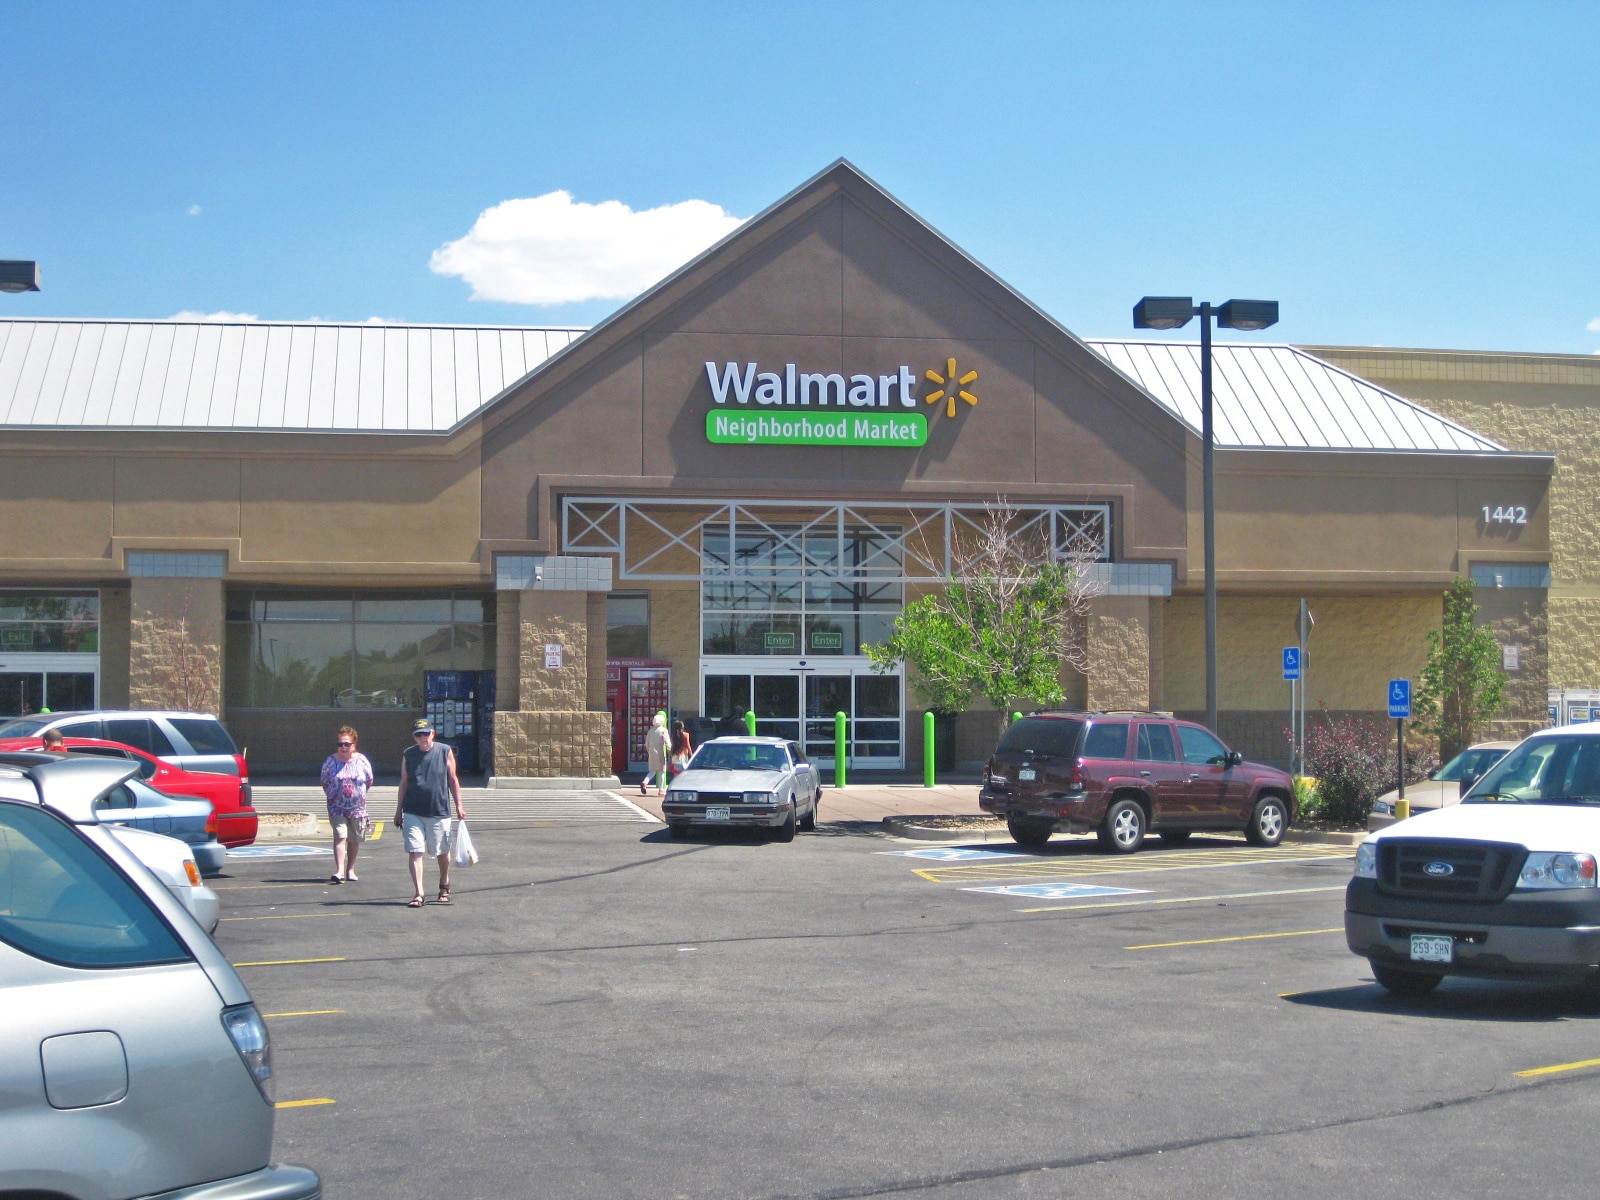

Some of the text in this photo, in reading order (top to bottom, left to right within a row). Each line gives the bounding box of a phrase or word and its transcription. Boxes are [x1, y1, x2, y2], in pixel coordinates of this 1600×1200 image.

[705, 361, 917, 408] Walmart
[715, 416, 918, 442] Neighborhood Market
[1482, 506, 1527, 524] 1442
[767, 636, 791, 645] Enter
[815, 636, 838, 645] Enter
